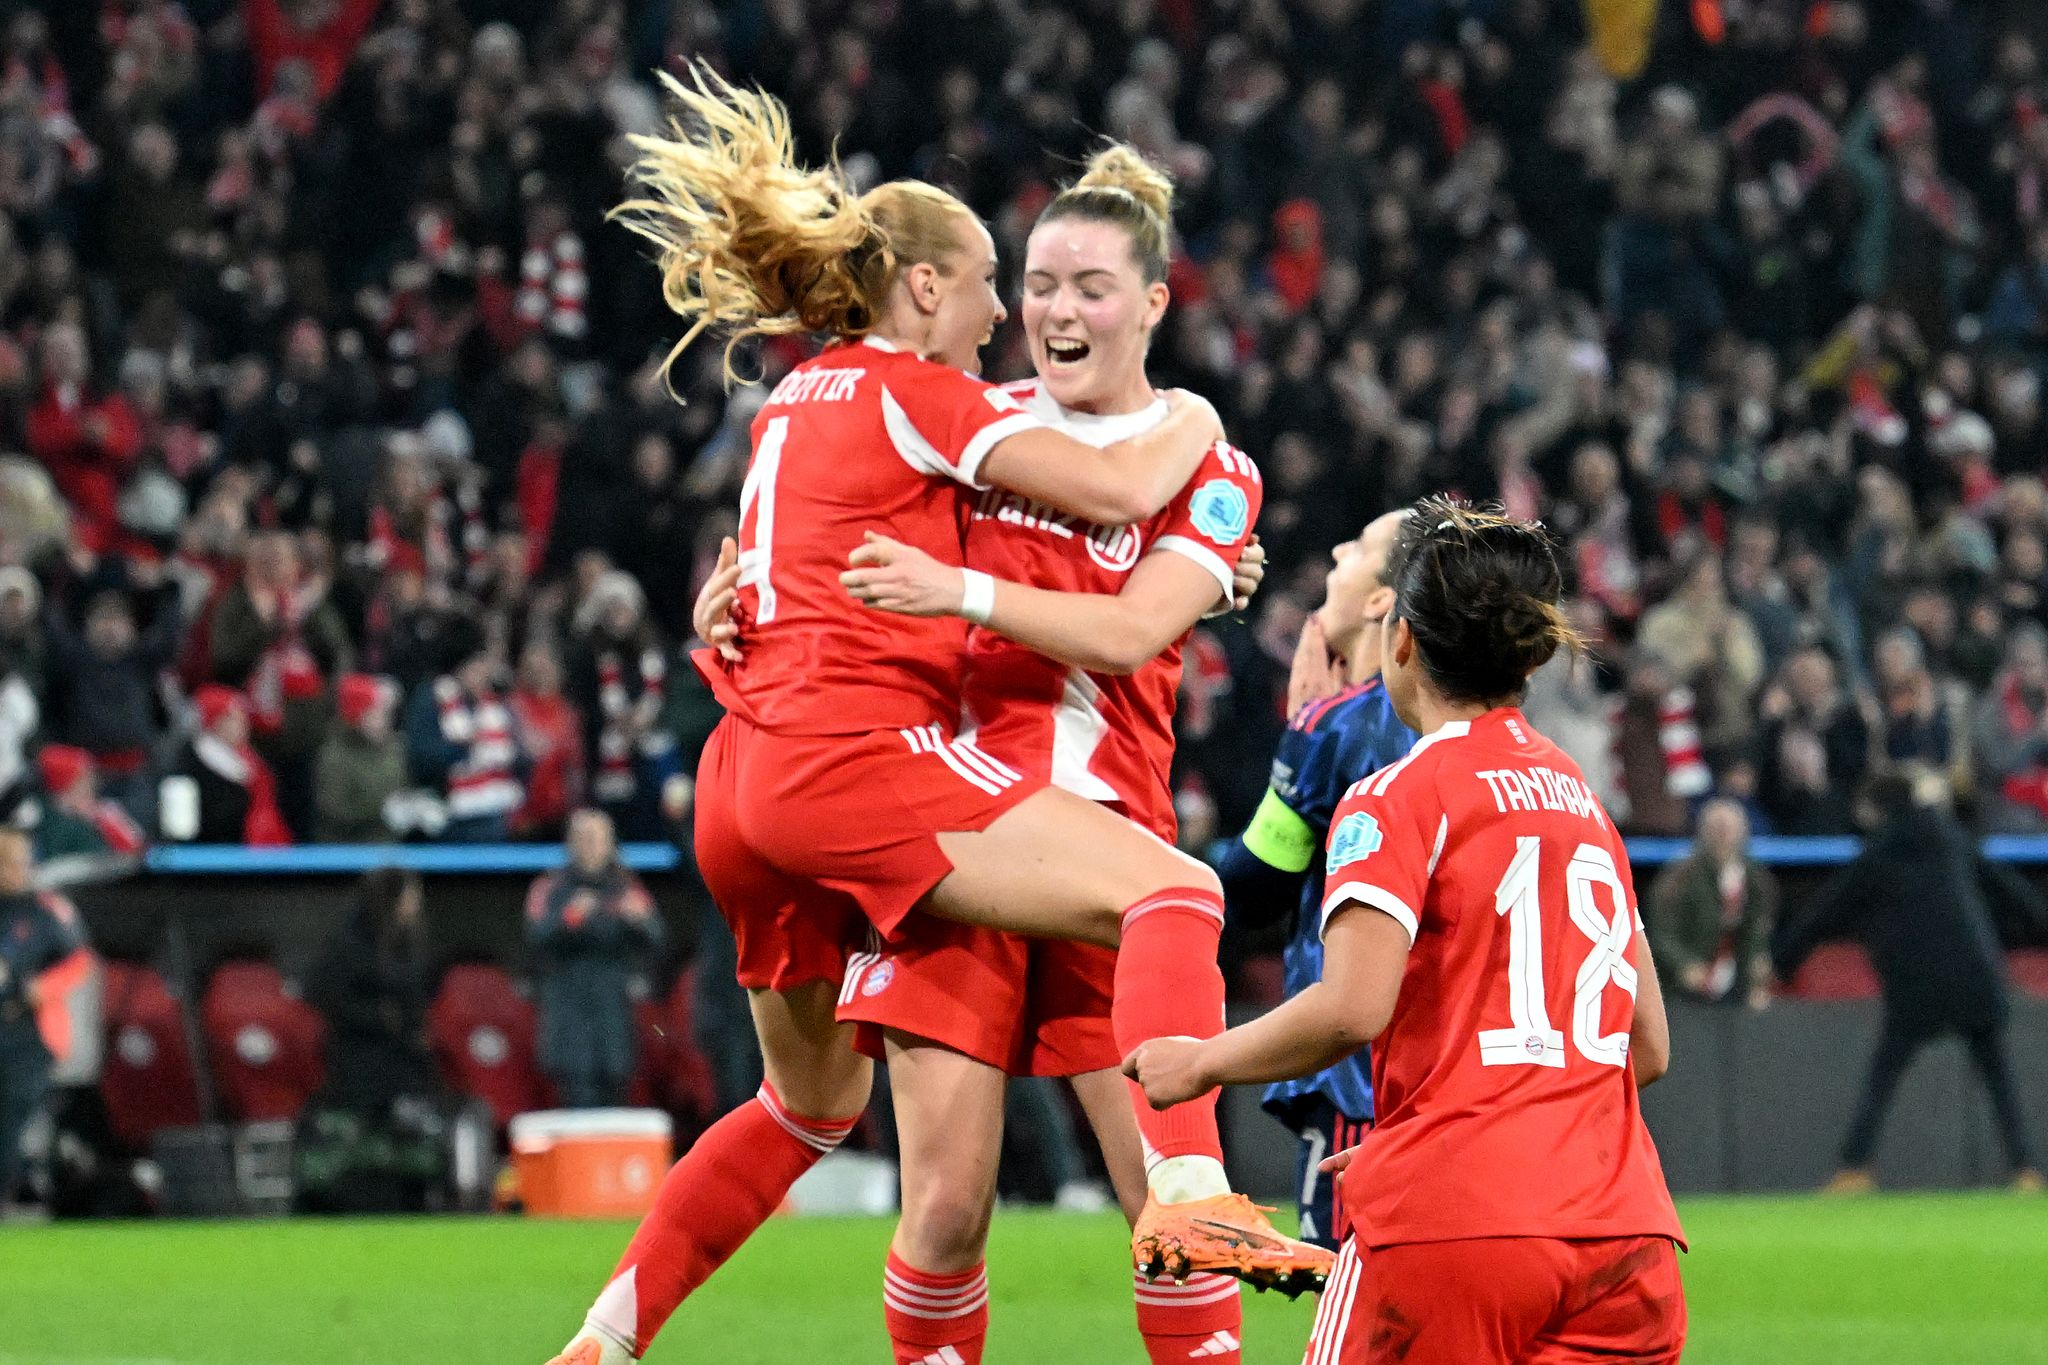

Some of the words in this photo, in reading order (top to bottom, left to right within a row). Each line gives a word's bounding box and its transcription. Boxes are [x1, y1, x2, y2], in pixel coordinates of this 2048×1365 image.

[735, 415, 790, 626] 4
[1474, 766, 1608, 832] TANIKAW
[1477, 835, 1639, 1070] 18
